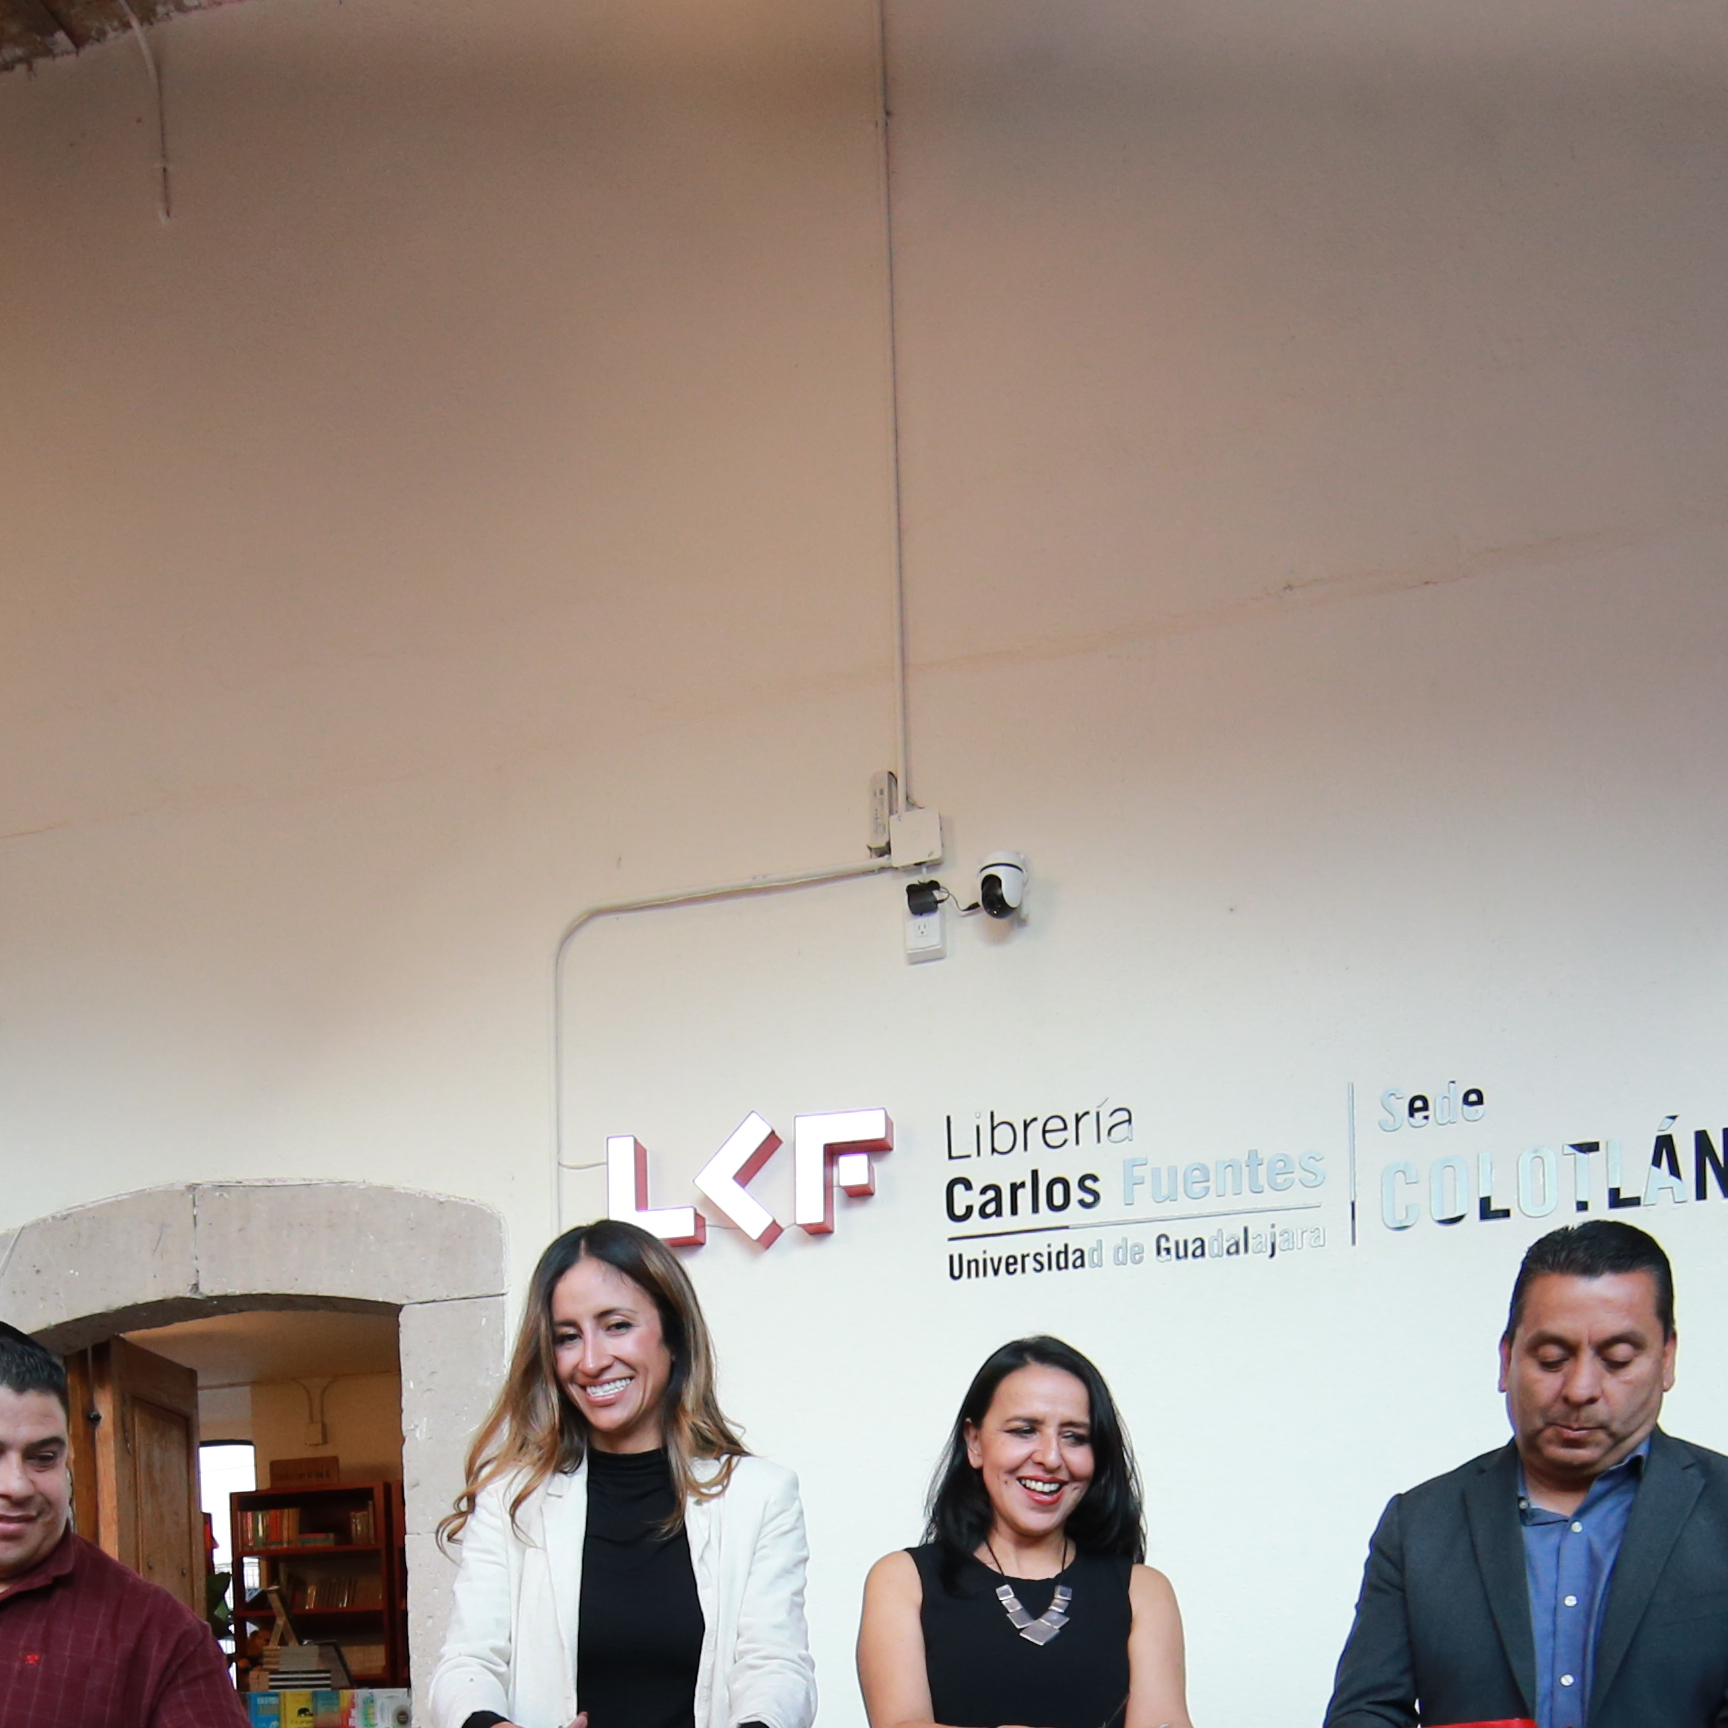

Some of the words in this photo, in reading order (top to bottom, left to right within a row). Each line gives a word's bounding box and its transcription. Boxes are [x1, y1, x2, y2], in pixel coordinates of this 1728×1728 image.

[945, 1097, 1134, 1161] Librería
[1378, 1080, 1485, 1132] Sede
[945, 1169, 1101, 1223] Carlos
[1123, 1149, 1326, 1205] Fuentes
[948, 1239, 1103, 1280] Universidad
[1113, 1237, 1145, 1266] de
[1155, 1224, 1326, 1262] Guadalajara
